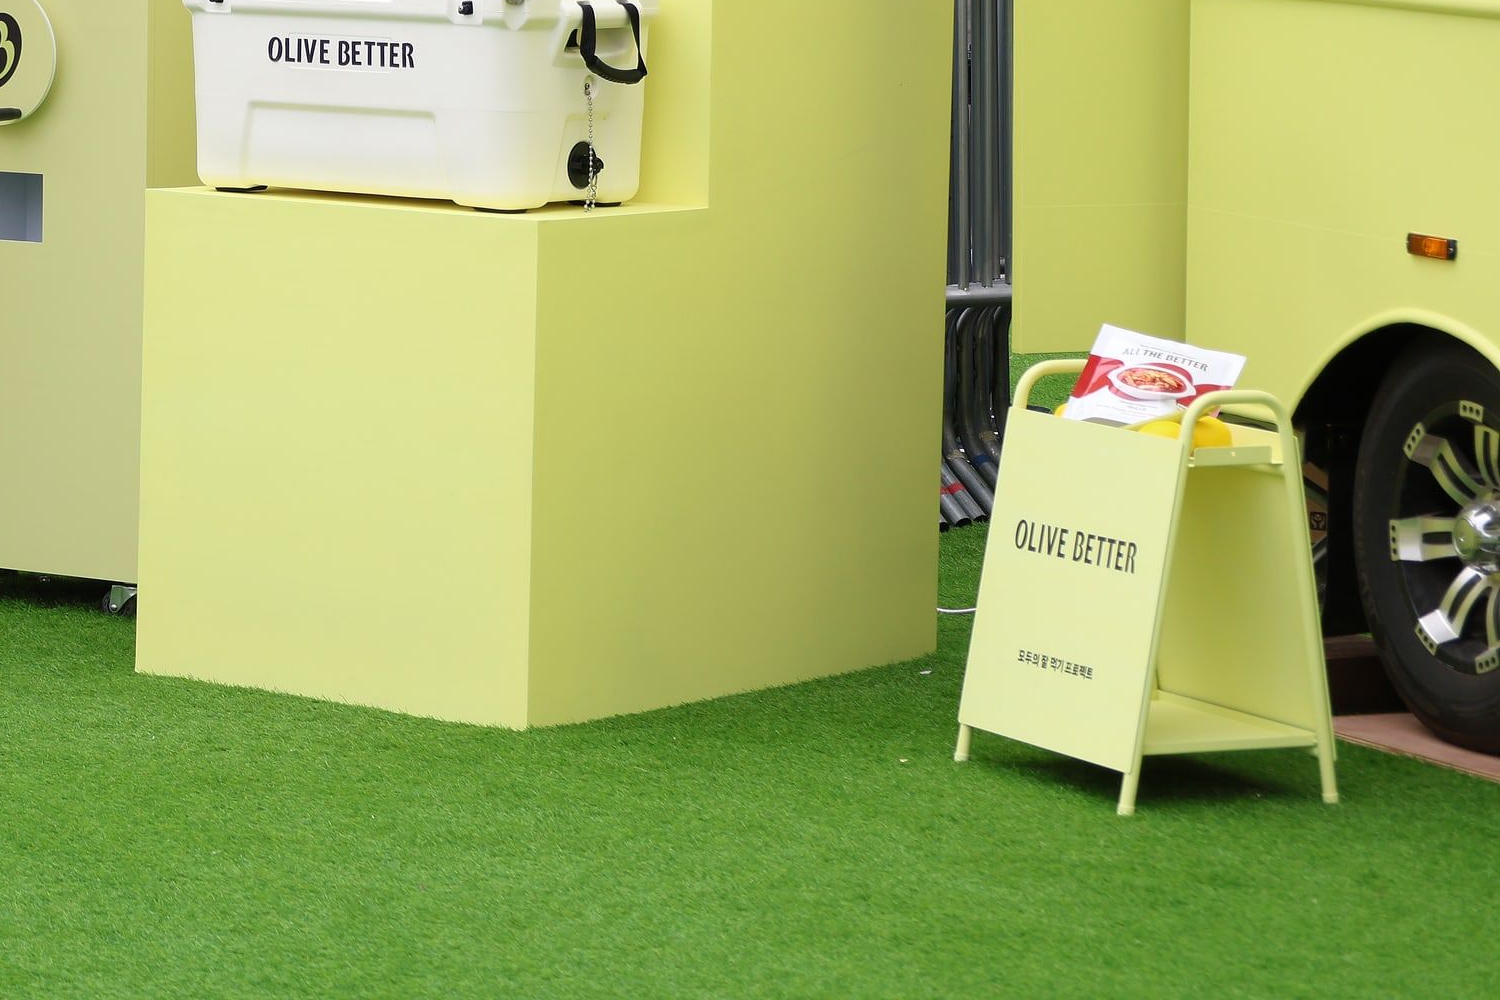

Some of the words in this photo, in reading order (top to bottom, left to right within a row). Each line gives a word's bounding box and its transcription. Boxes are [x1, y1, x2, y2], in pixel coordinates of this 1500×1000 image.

[268, 36, 330, 64] OLIVE
[338, 40, 414, 68] BETTER
[1143, 349, 1164, 360] THE
[1165, 354, 1208, 371] BETTER
[1015, 519, 1069, 559] OLIVE
[1072, 530, 1138, 574] BETTER
[1017, 649, 1040, 667] 모두의
[1064, 661, 1093, 680] 프로젝트
